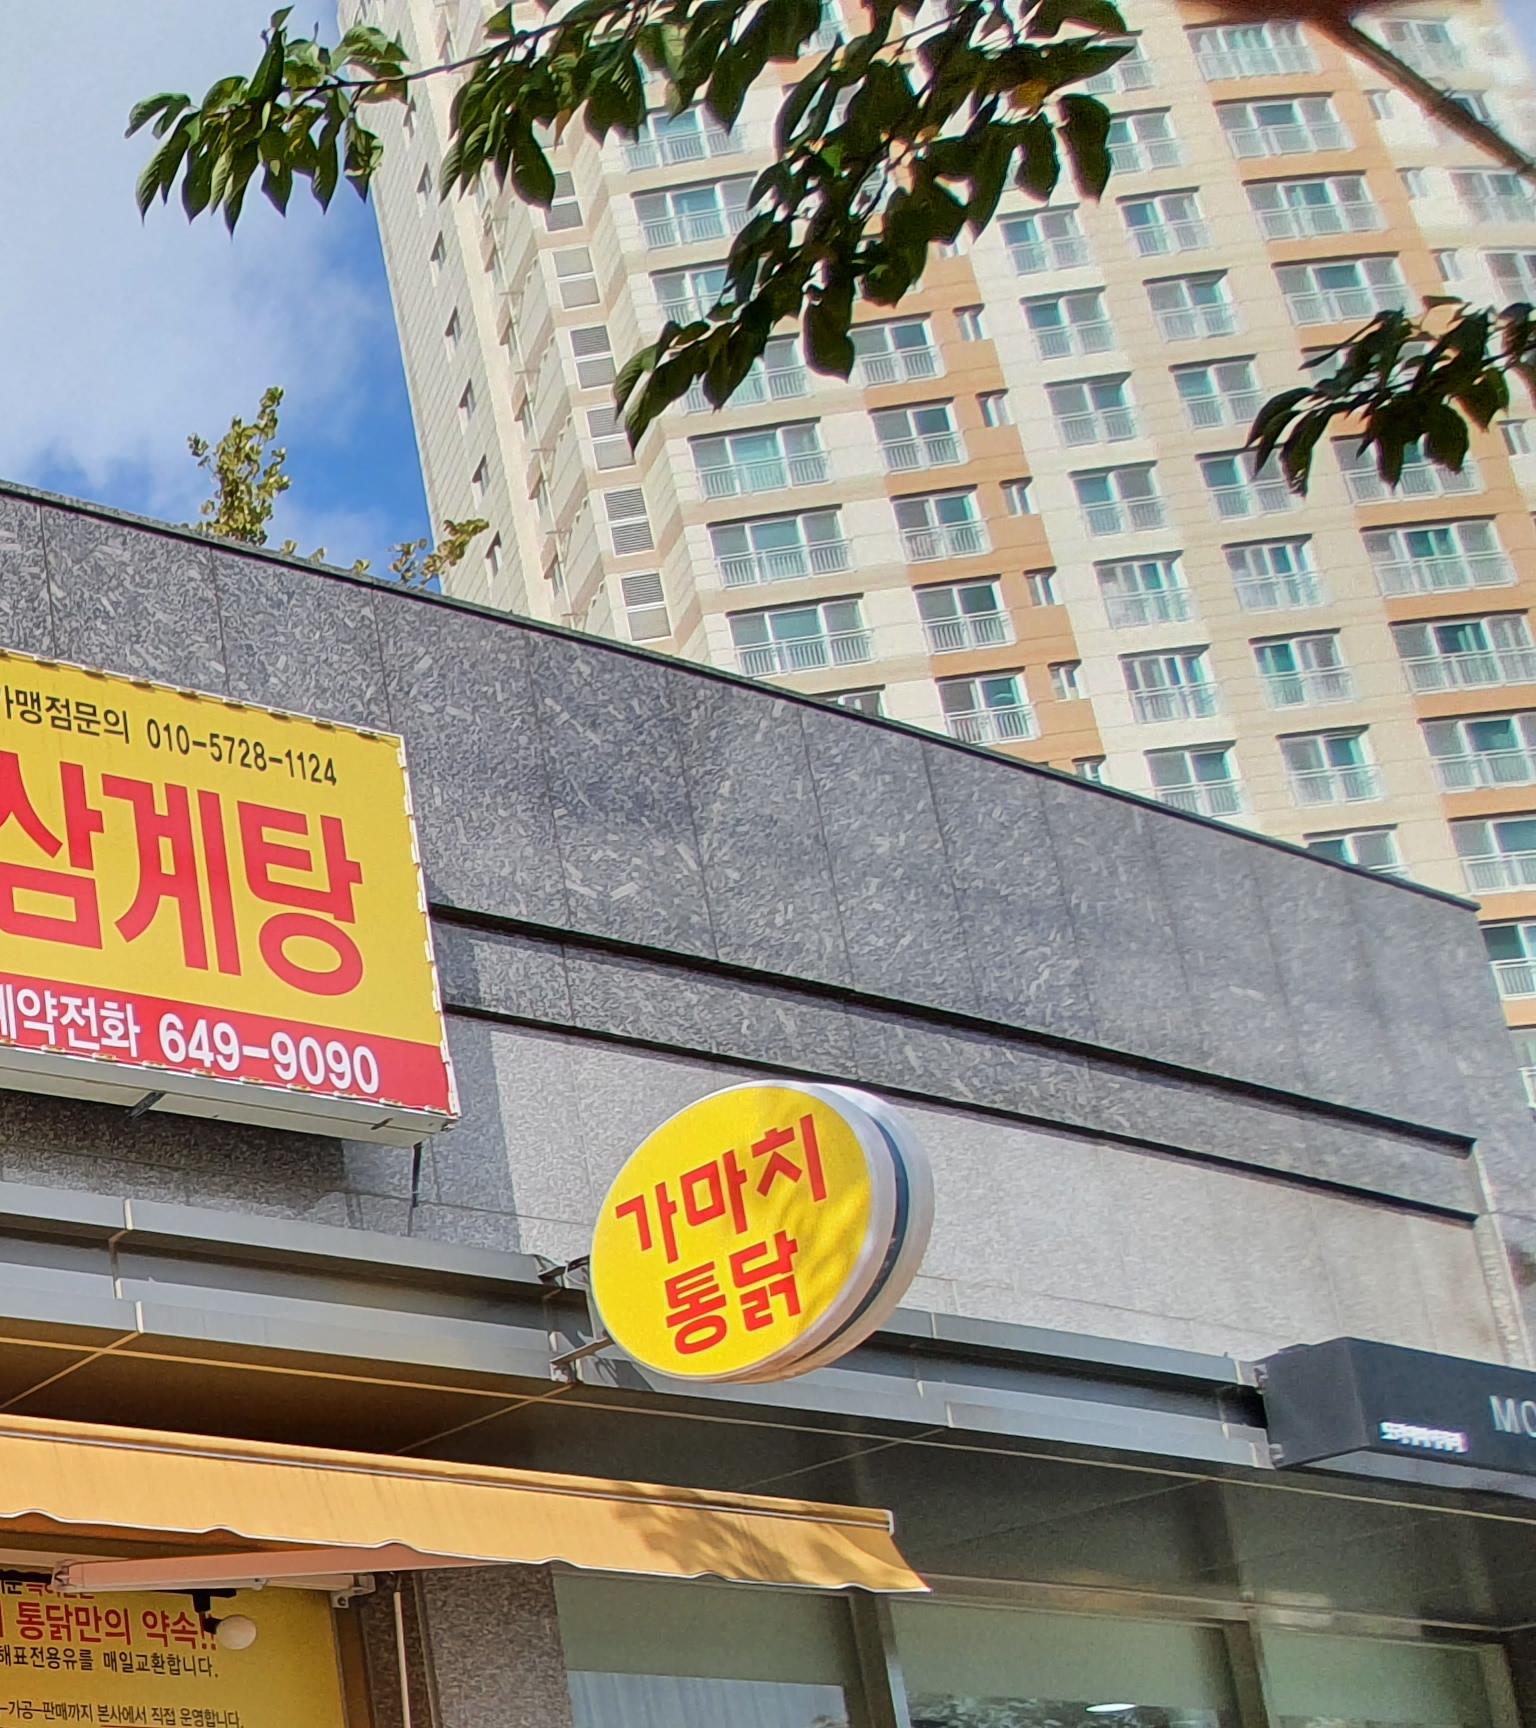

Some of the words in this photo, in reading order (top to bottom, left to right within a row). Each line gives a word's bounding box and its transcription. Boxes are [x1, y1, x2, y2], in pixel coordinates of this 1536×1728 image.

[147, 720, 338, 788] 010-5728-1124
[158, 1011, 379, 1095] 649-9090
[616, 1113, 827, 1264] 가마치
[664, 1230, 802, 1355] 통닭
[16, 1601, 131, 1645] 통닭만의
[103, 1651, 219, 1678] 매일교환합니다.
[97, 1704, 147, 1724] 본사에서
[151, 1707, 176, 1726] 직접
